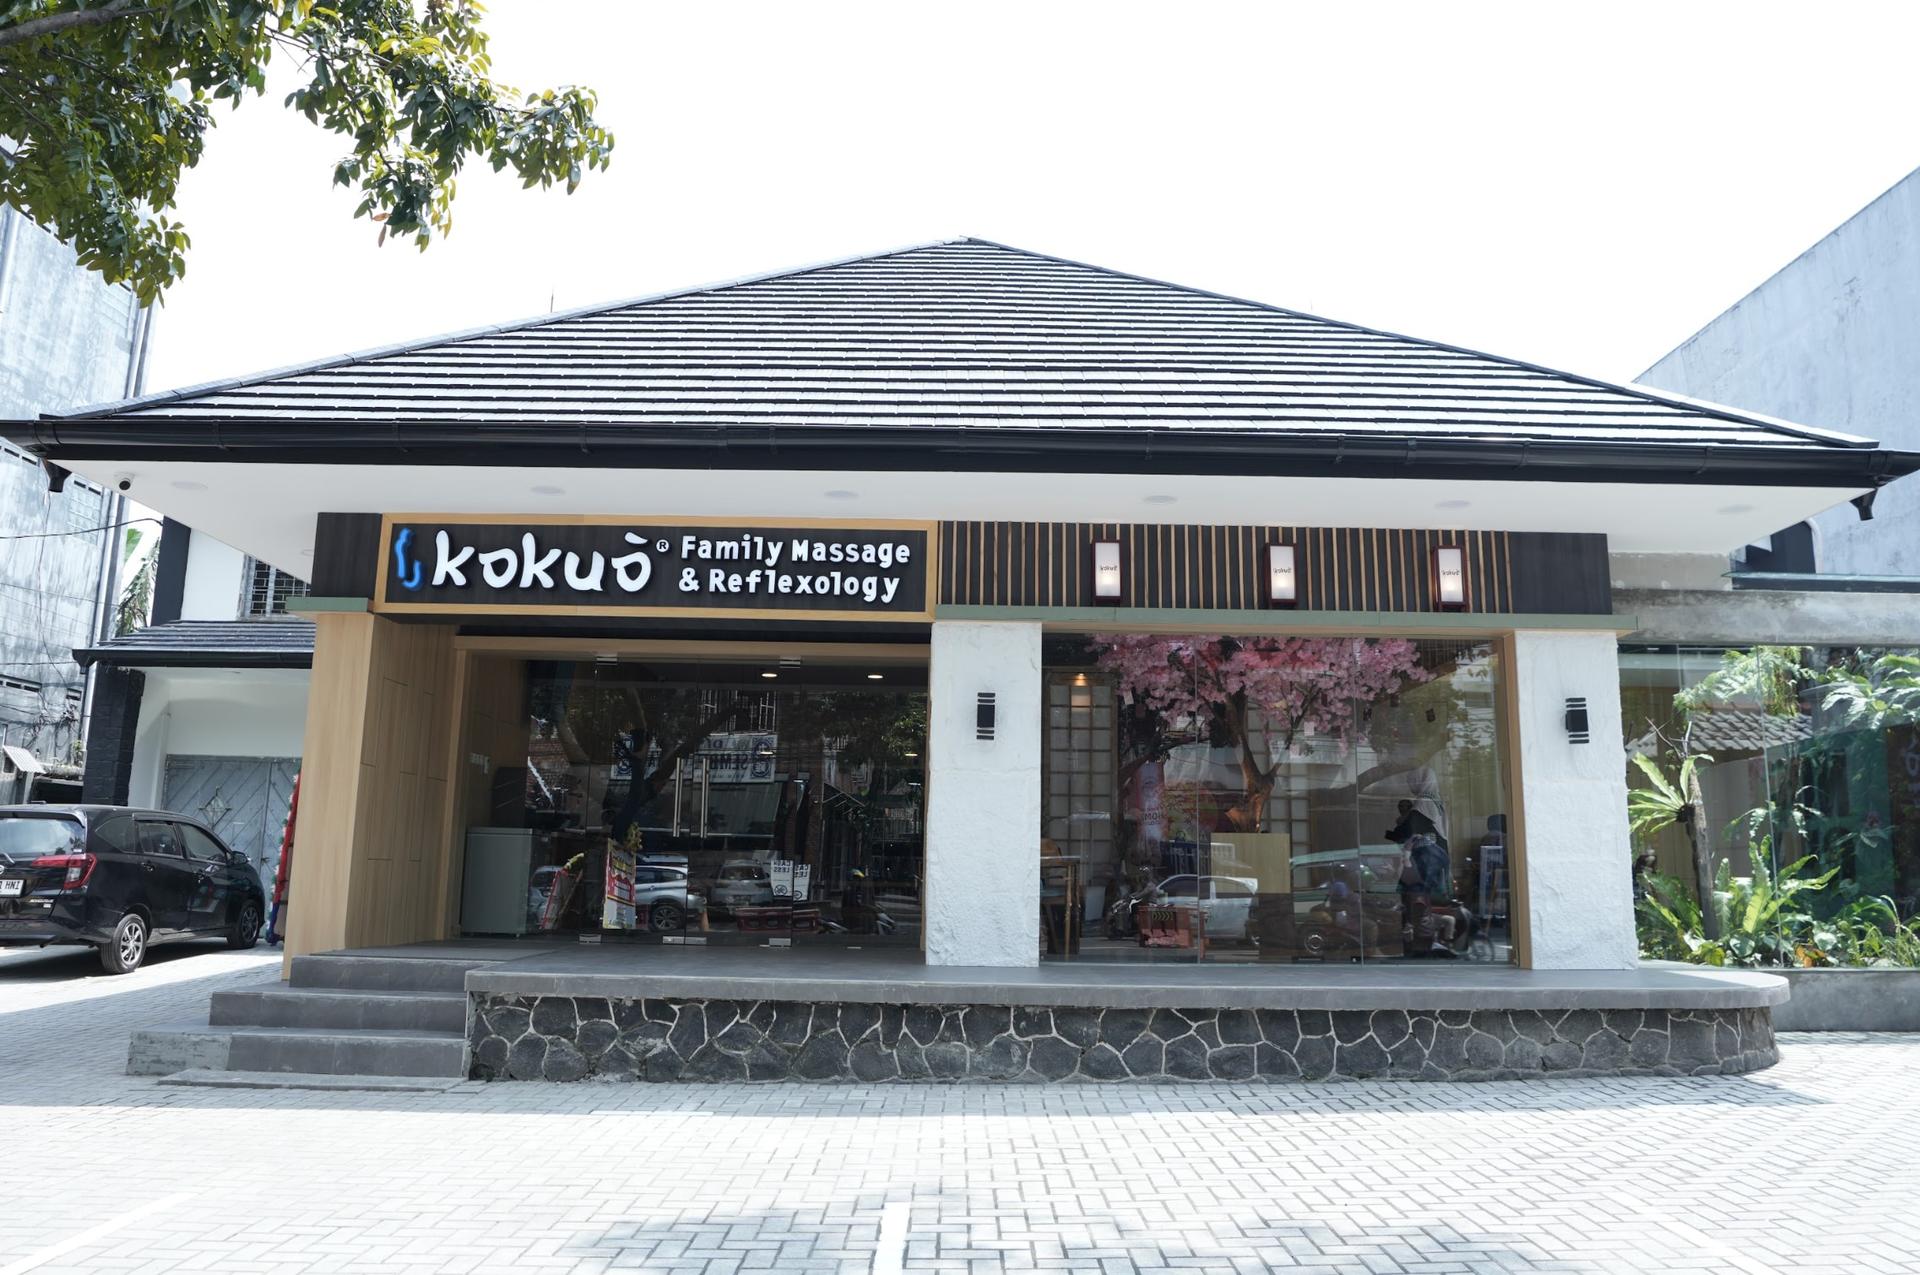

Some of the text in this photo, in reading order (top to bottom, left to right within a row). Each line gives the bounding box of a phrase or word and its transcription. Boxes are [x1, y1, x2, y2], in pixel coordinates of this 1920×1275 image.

[681, 533, 911, 569] Family Massage
[678, 567, 900, 604] & Reflexology
